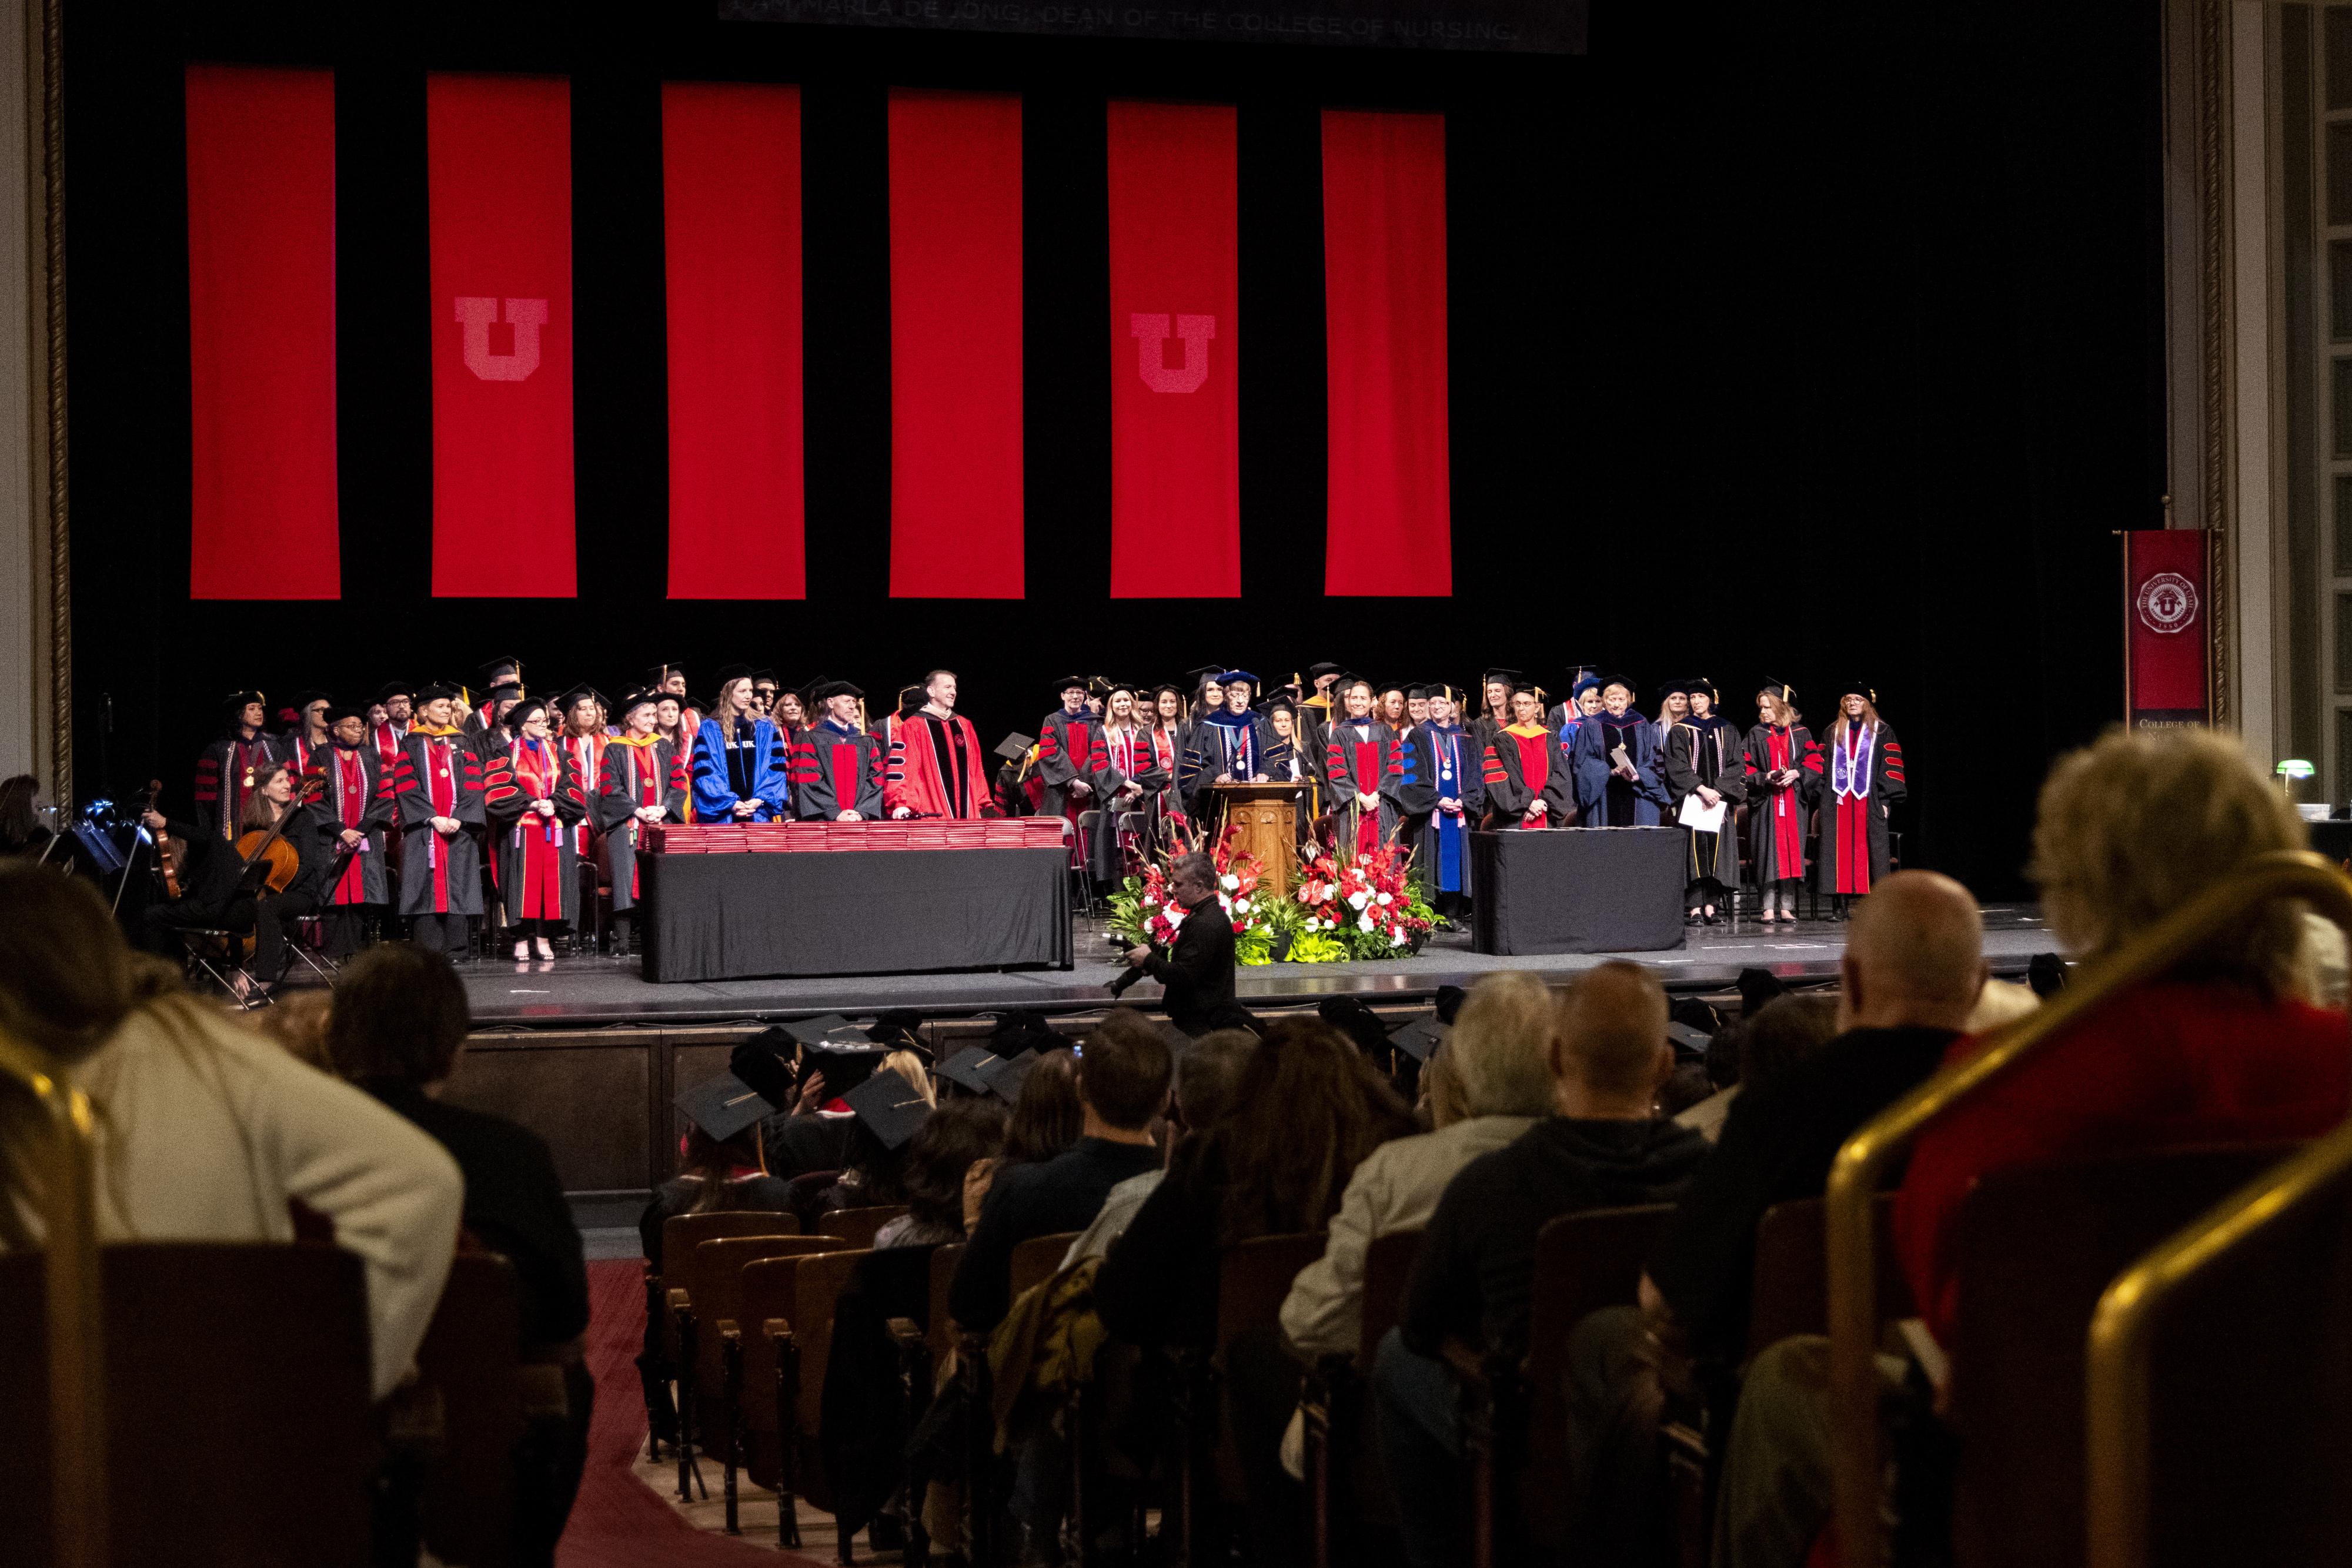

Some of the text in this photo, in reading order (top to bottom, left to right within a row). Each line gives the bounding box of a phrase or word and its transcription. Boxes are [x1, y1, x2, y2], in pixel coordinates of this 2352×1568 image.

[904, 1, 938, 18] DE
[1043, 6, 1113, 25] DEAN
[1124, 9, 1158, 26] OF
[1167, 11, 1217, 29] THE
[1227, 14, 1342, 34] COLLEGE
[1351, 18, 1384, 35] OF
[455, 297, 547, 382] U
[1131, 313, 1215, 393] U
[2144, 577, 2179, 594] UNIVERSITY
[2180, 582, 2188, 590] OF
